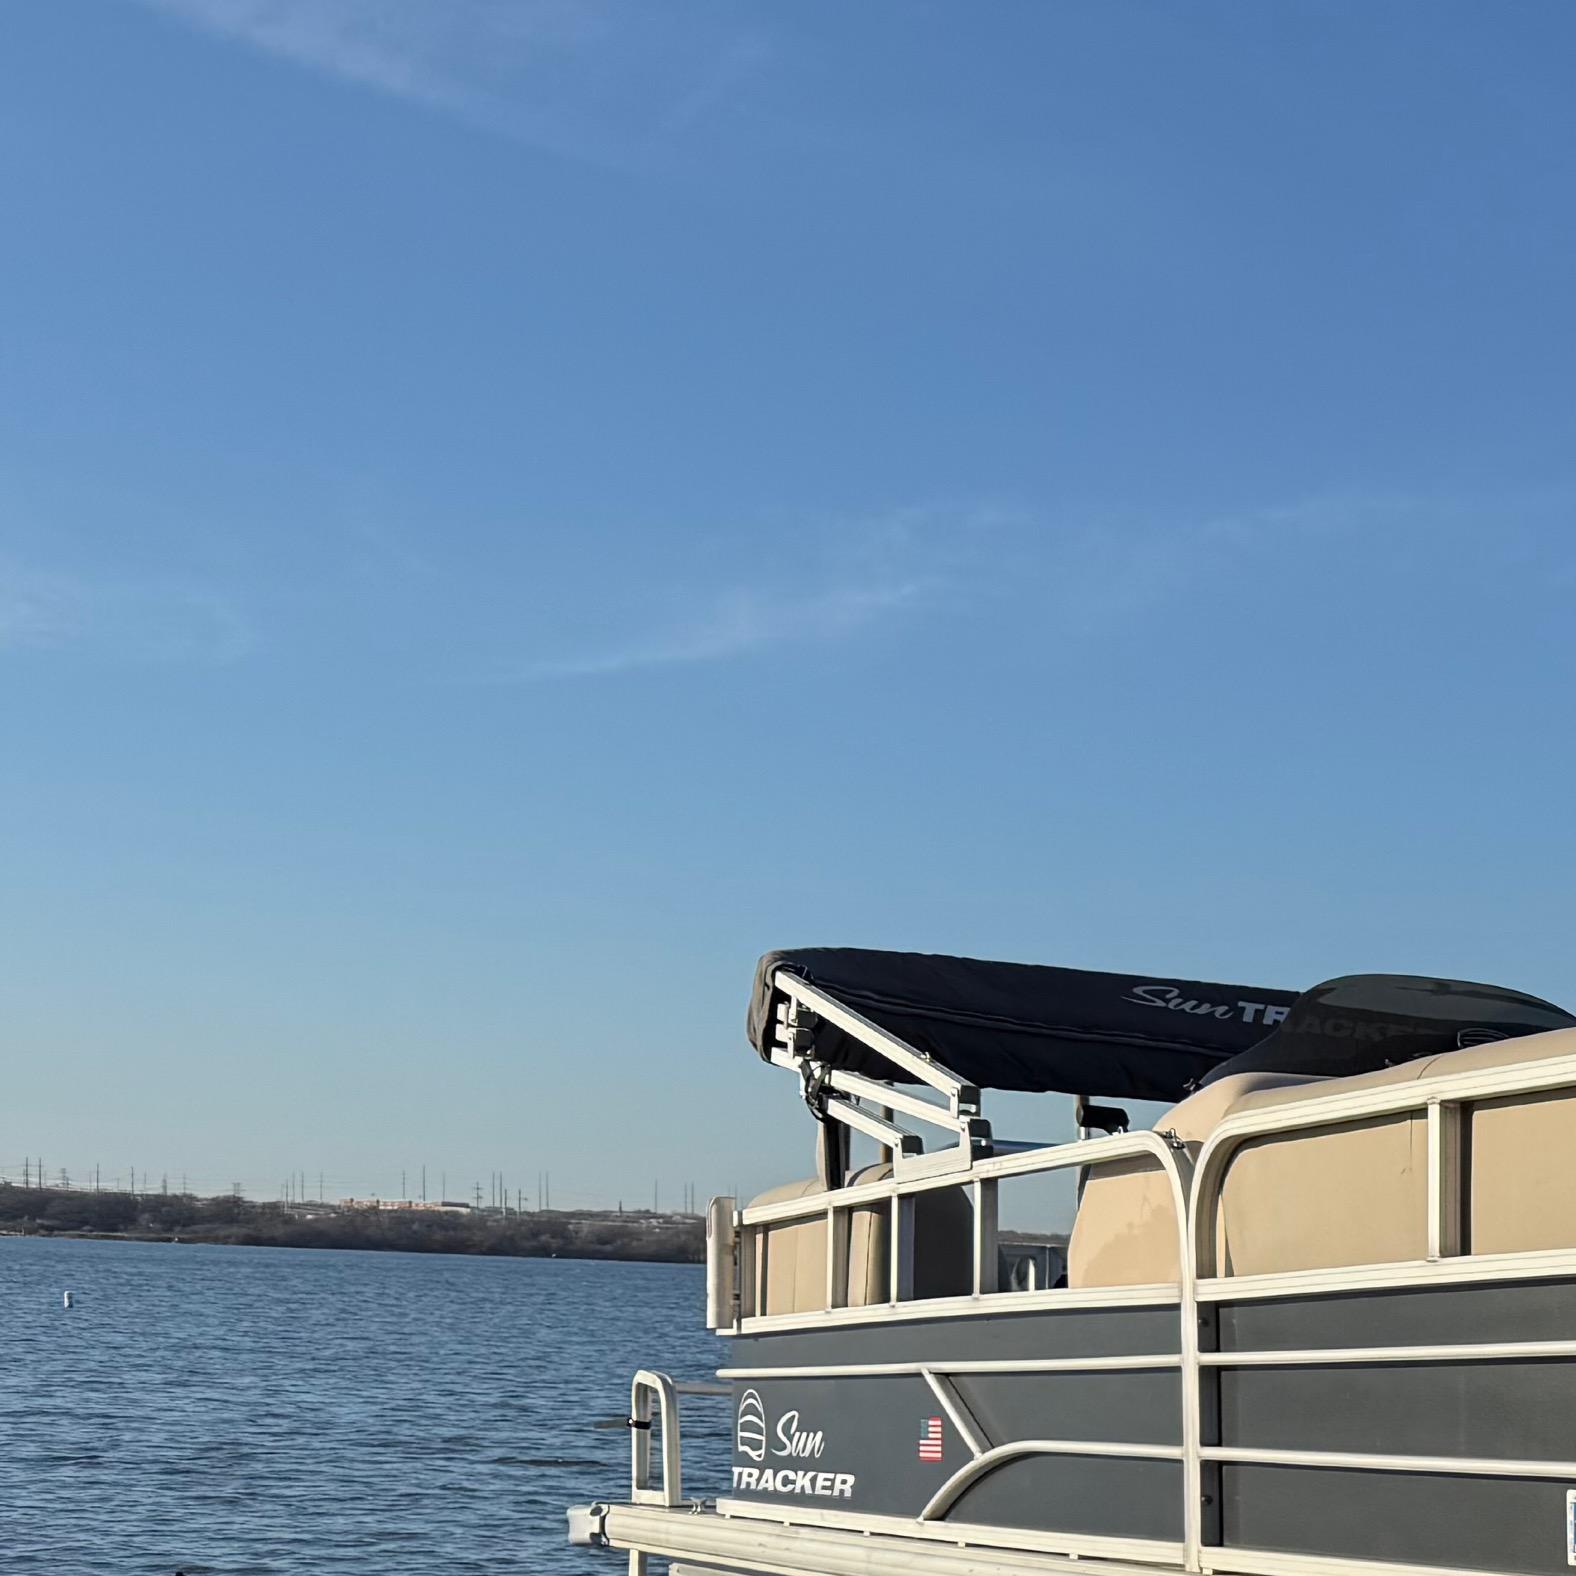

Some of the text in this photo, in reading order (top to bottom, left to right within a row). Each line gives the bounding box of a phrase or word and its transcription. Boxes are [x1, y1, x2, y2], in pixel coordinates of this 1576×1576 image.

[1120, 985, 1236, 1020] Sun
[770, 1410, 825, 1459] Sun
[731, 1466, 856, 1498] TRACKER
